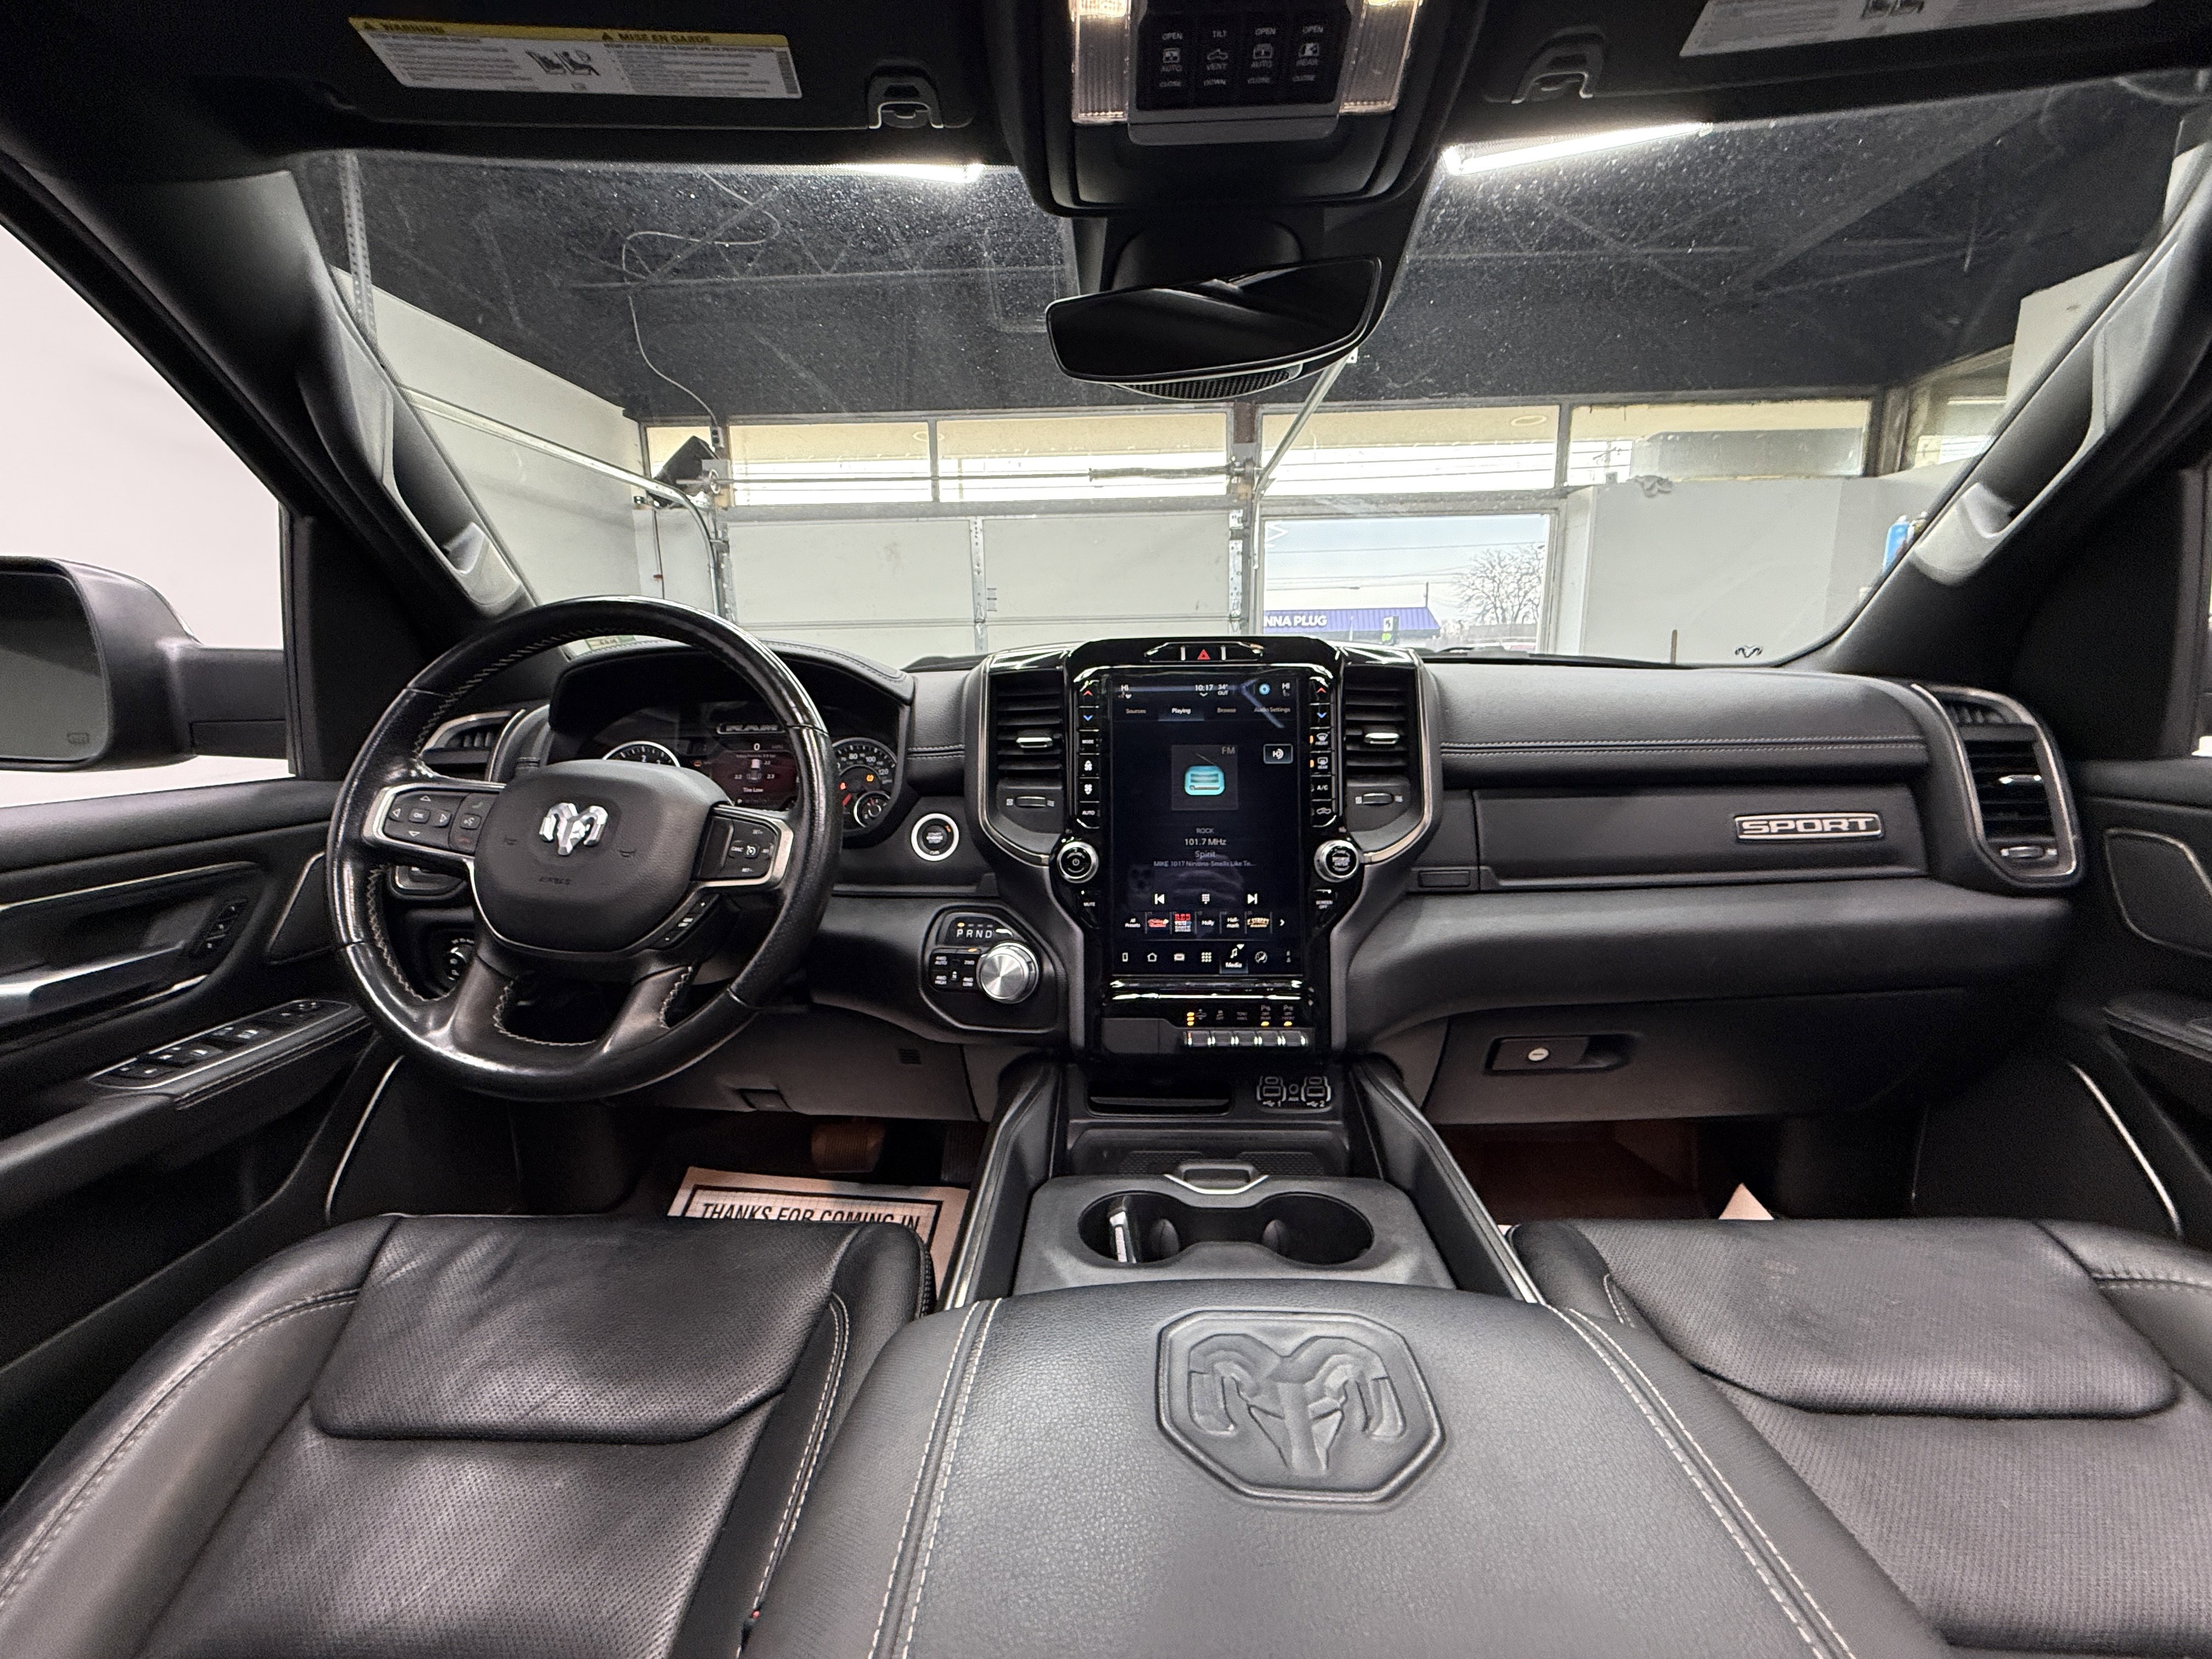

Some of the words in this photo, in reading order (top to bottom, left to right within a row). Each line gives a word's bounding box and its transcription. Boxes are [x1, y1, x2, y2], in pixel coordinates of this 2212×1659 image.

[1255, 27, 1276, 36] OPEN
[1302, 25, 1323, 33] OPEN
[671, 35, 712, 43] GARDE
[1294, 615, 1327, 626] PLUG
[754, 743, 760, 751] 0
[642, 754, 647, 763] 2
[1742, 817, 1876, 834] SPORT
[1195, 850, 1216, 859] Spirit
[956, 929, 963, 938] P
[966, 929, 974, 938] R
[975, 930, 983, 938] N
[985, 930, 992, 939] D
[701, 1203, 772, 1220] THANKS
[777, 1207, 815, 1221] FOR
[901, 1215, 921, 1231] IN
